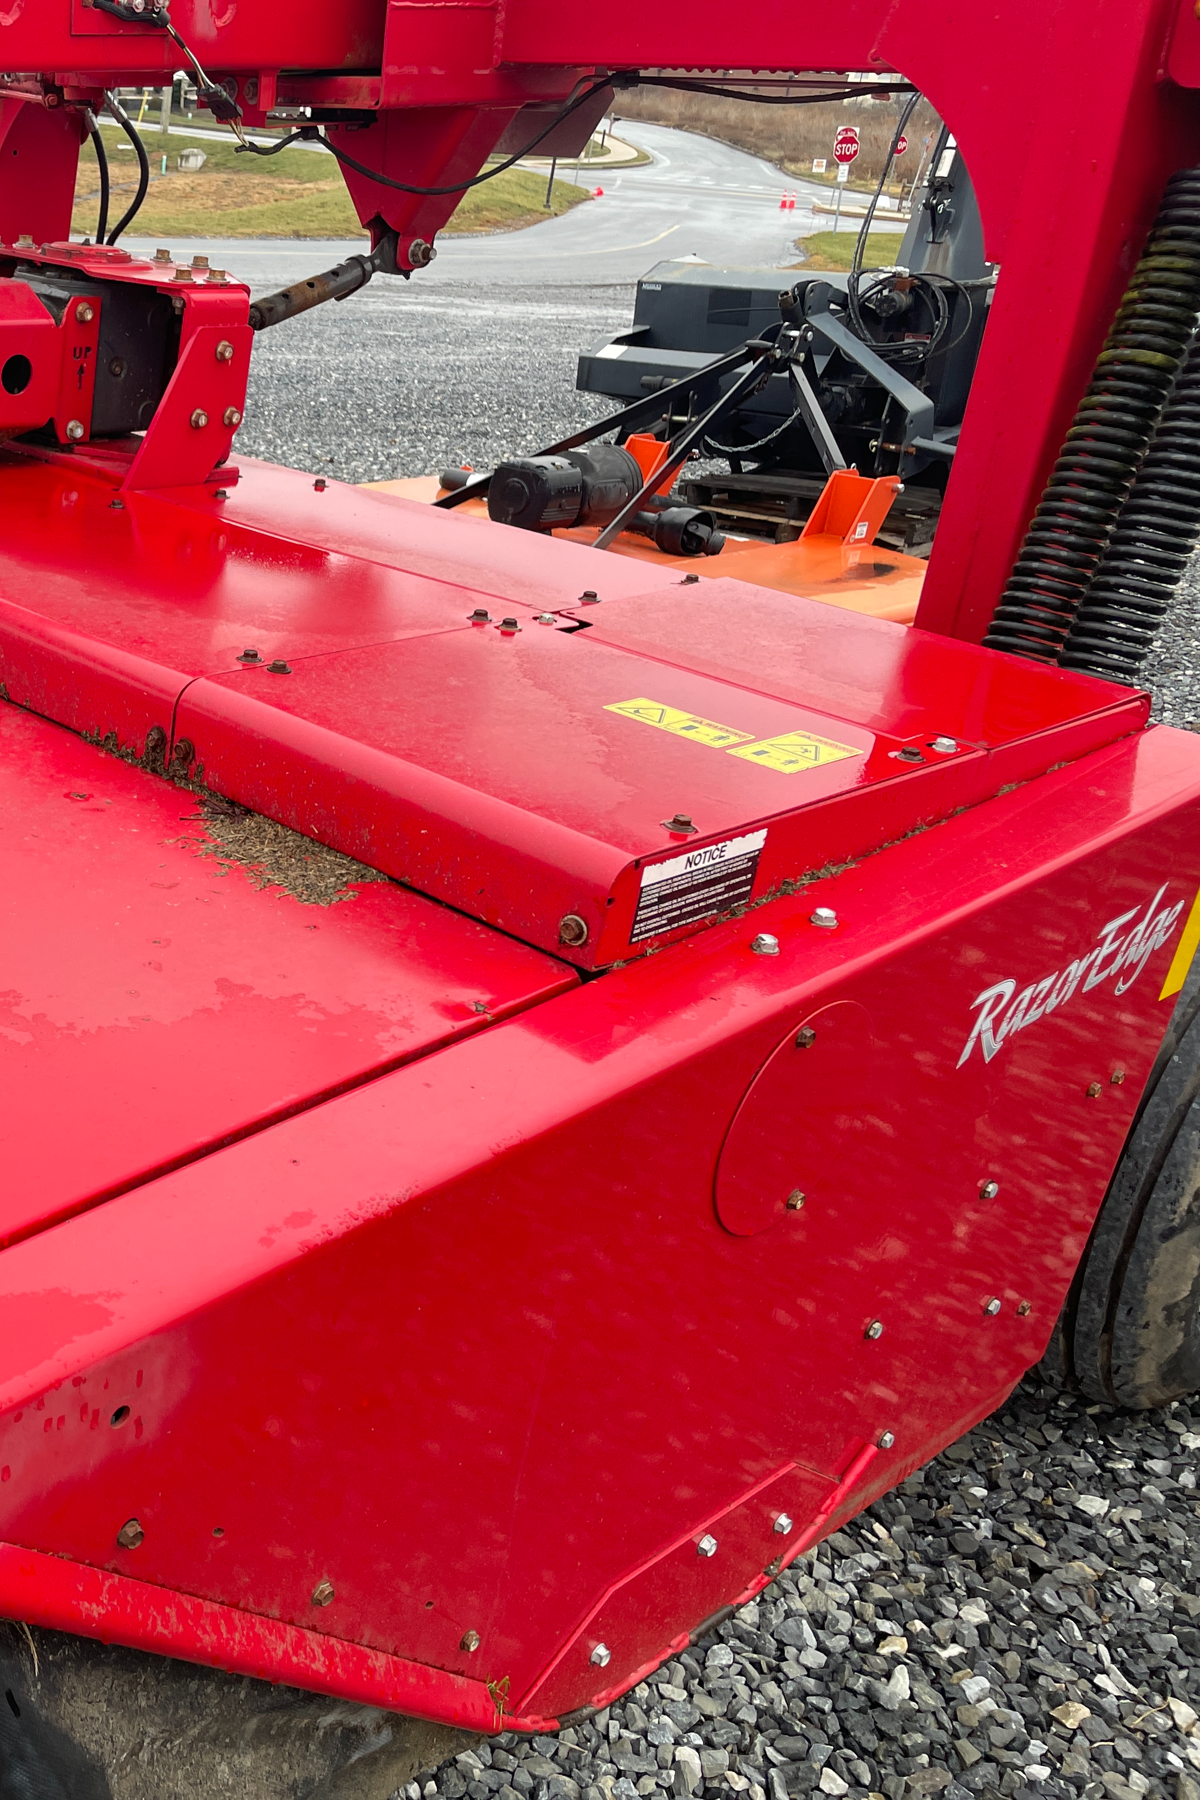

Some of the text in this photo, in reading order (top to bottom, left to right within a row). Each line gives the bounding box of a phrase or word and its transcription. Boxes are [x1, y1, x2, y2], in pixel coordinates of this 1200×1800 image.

[835, 143, 858, 156] STOP
[72, 346, 92, 360] UP
[684, 844, 728, 870] NOTICE
[956, 881, 1185, 1070] RazorEdge
